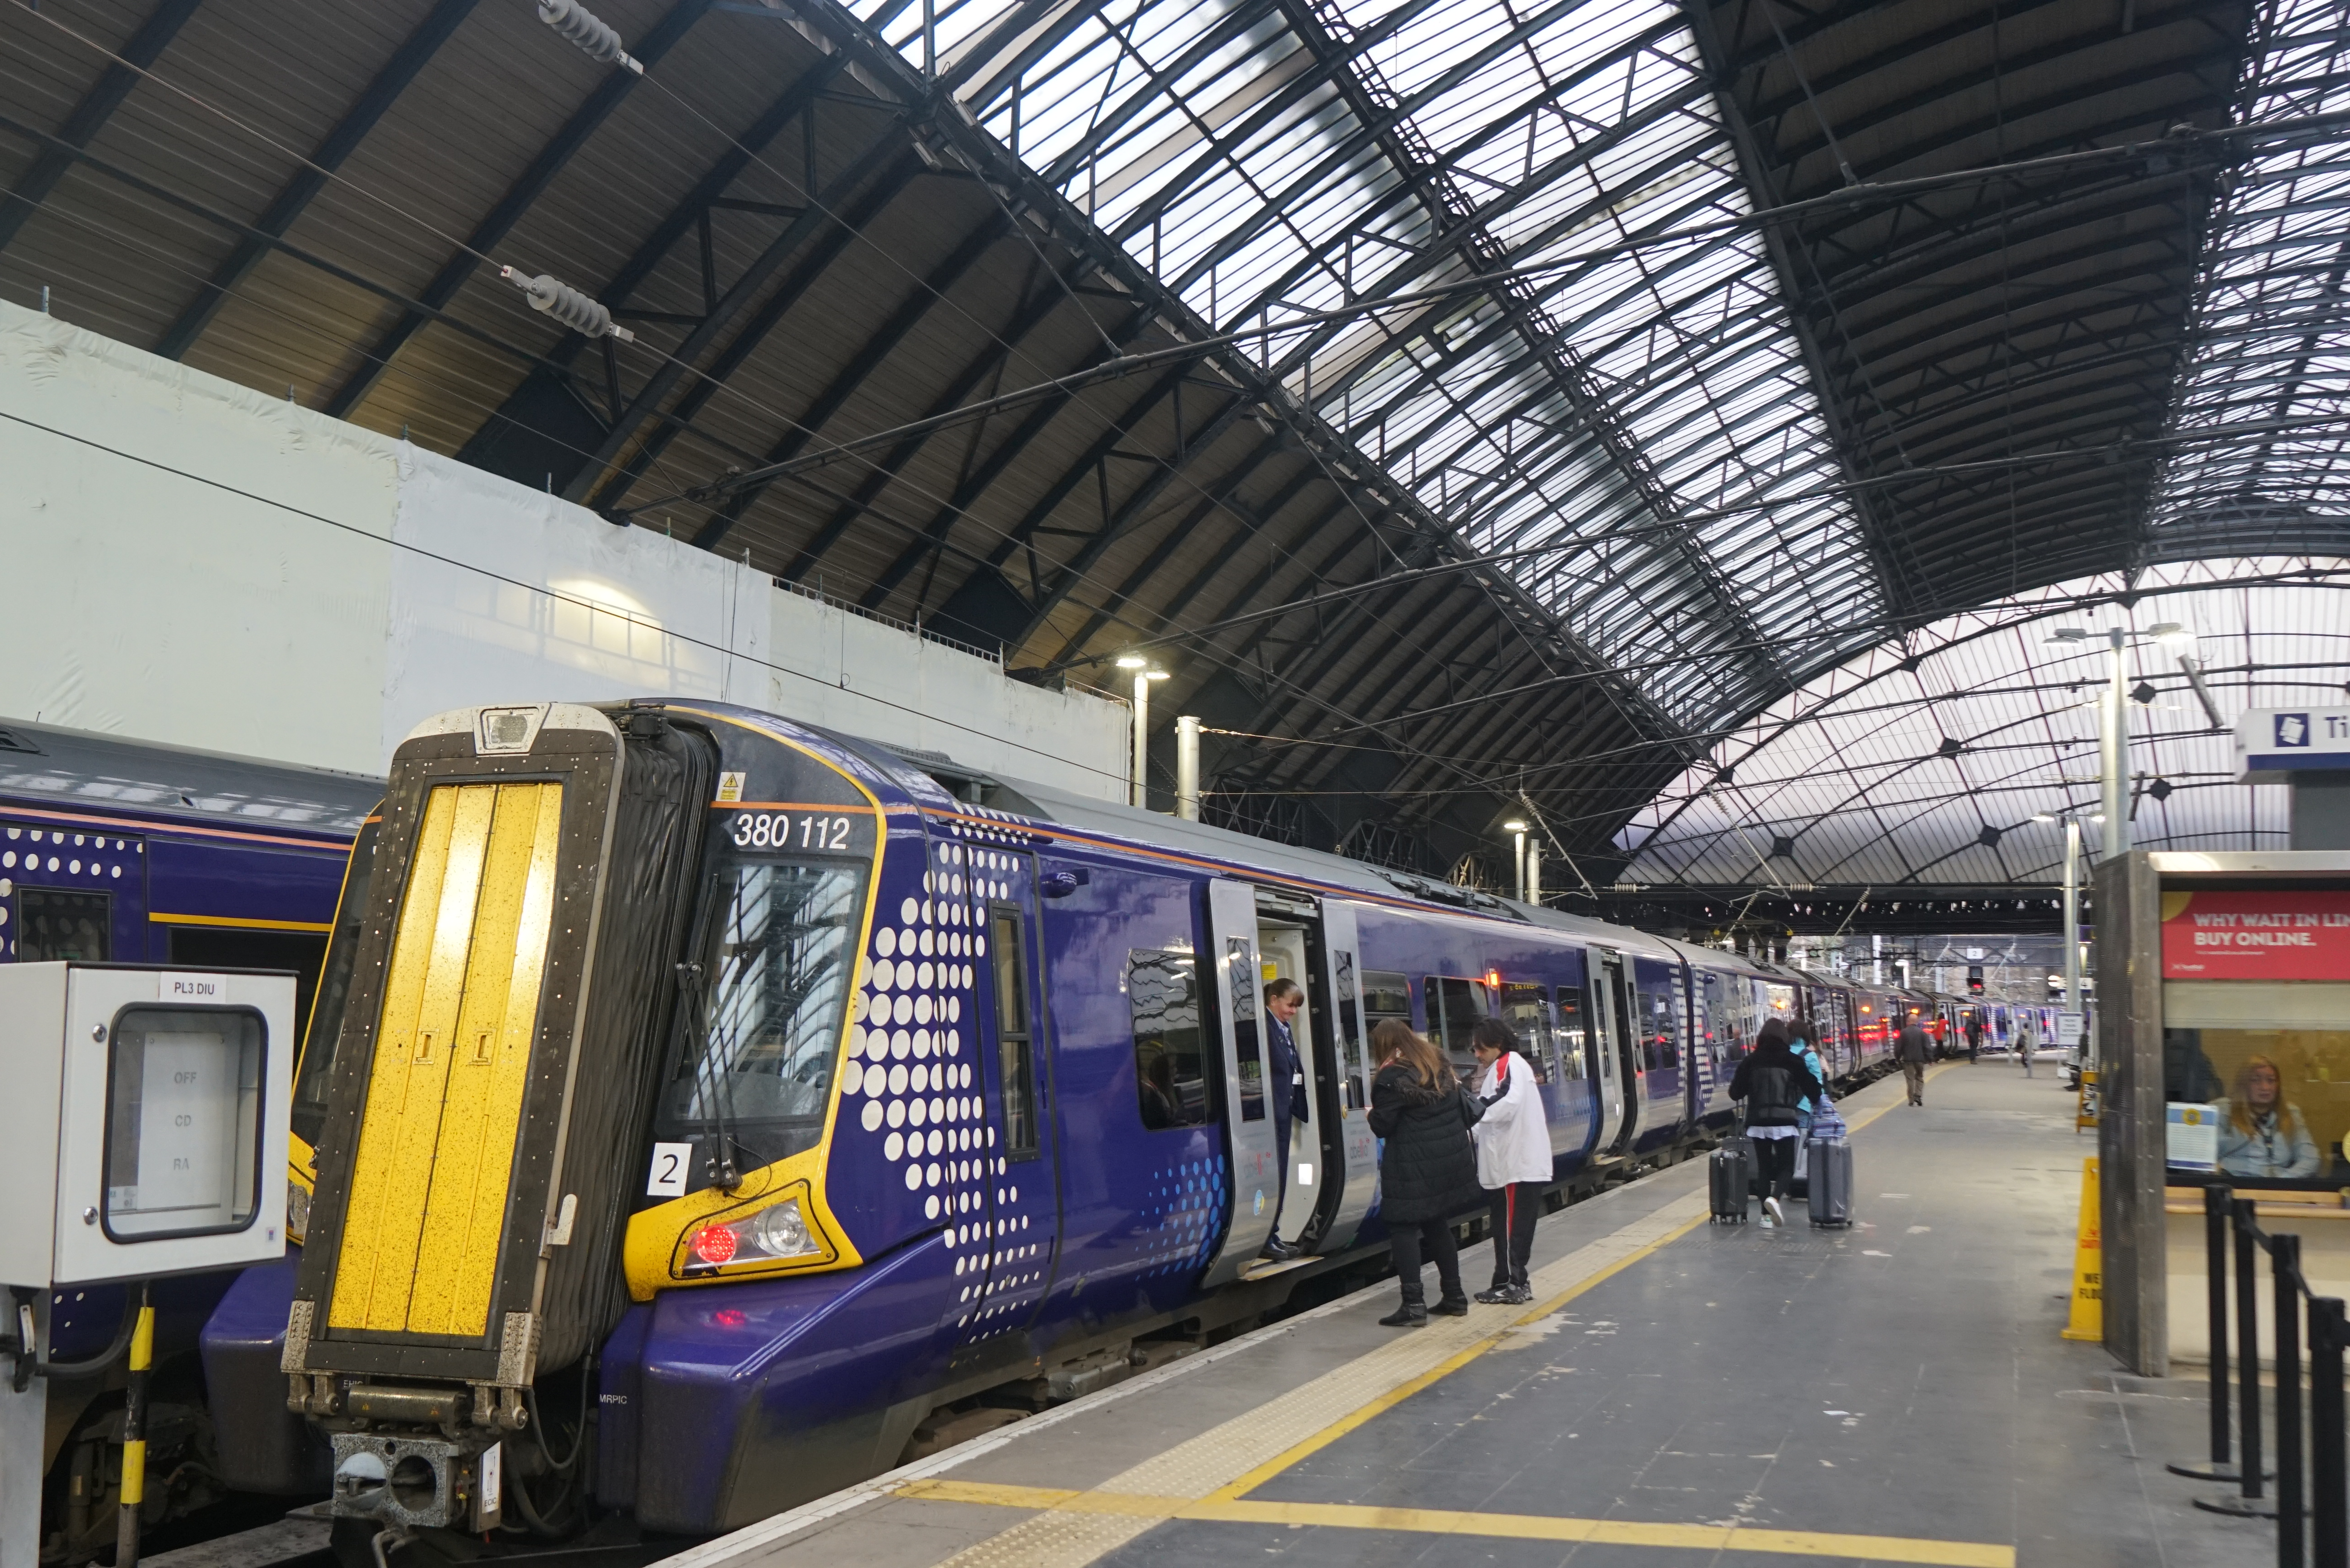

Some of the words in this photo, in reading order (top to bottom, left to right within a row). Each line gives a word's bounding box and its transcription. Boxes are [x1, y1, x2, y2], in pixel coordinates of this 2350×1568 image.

[734, 814, 789, 847] 380
[800, 816, 850, 849] 112
[2193, 913, 2238, 927] WHY
[2240, 913, 2291, 927] WAIT
[2295, 913, 2319, 927] IN
[2194, 932, 2234, 945] BUY
[2235, 932, 2317, 946] ONLINE.
[175, 981, 194, 994] PL3
[197, 983, 215, 995] DIU
[174, 1071, 197, 1084] OFF
[175, 1115, 191, 1127] CD
[174, 1158, 190, 1171] RA
[659, 1154, 678, 1183] 2
[599, 1394, 627, 1404] MRPIC
[484, 1497, 497, 1507] ECIC
